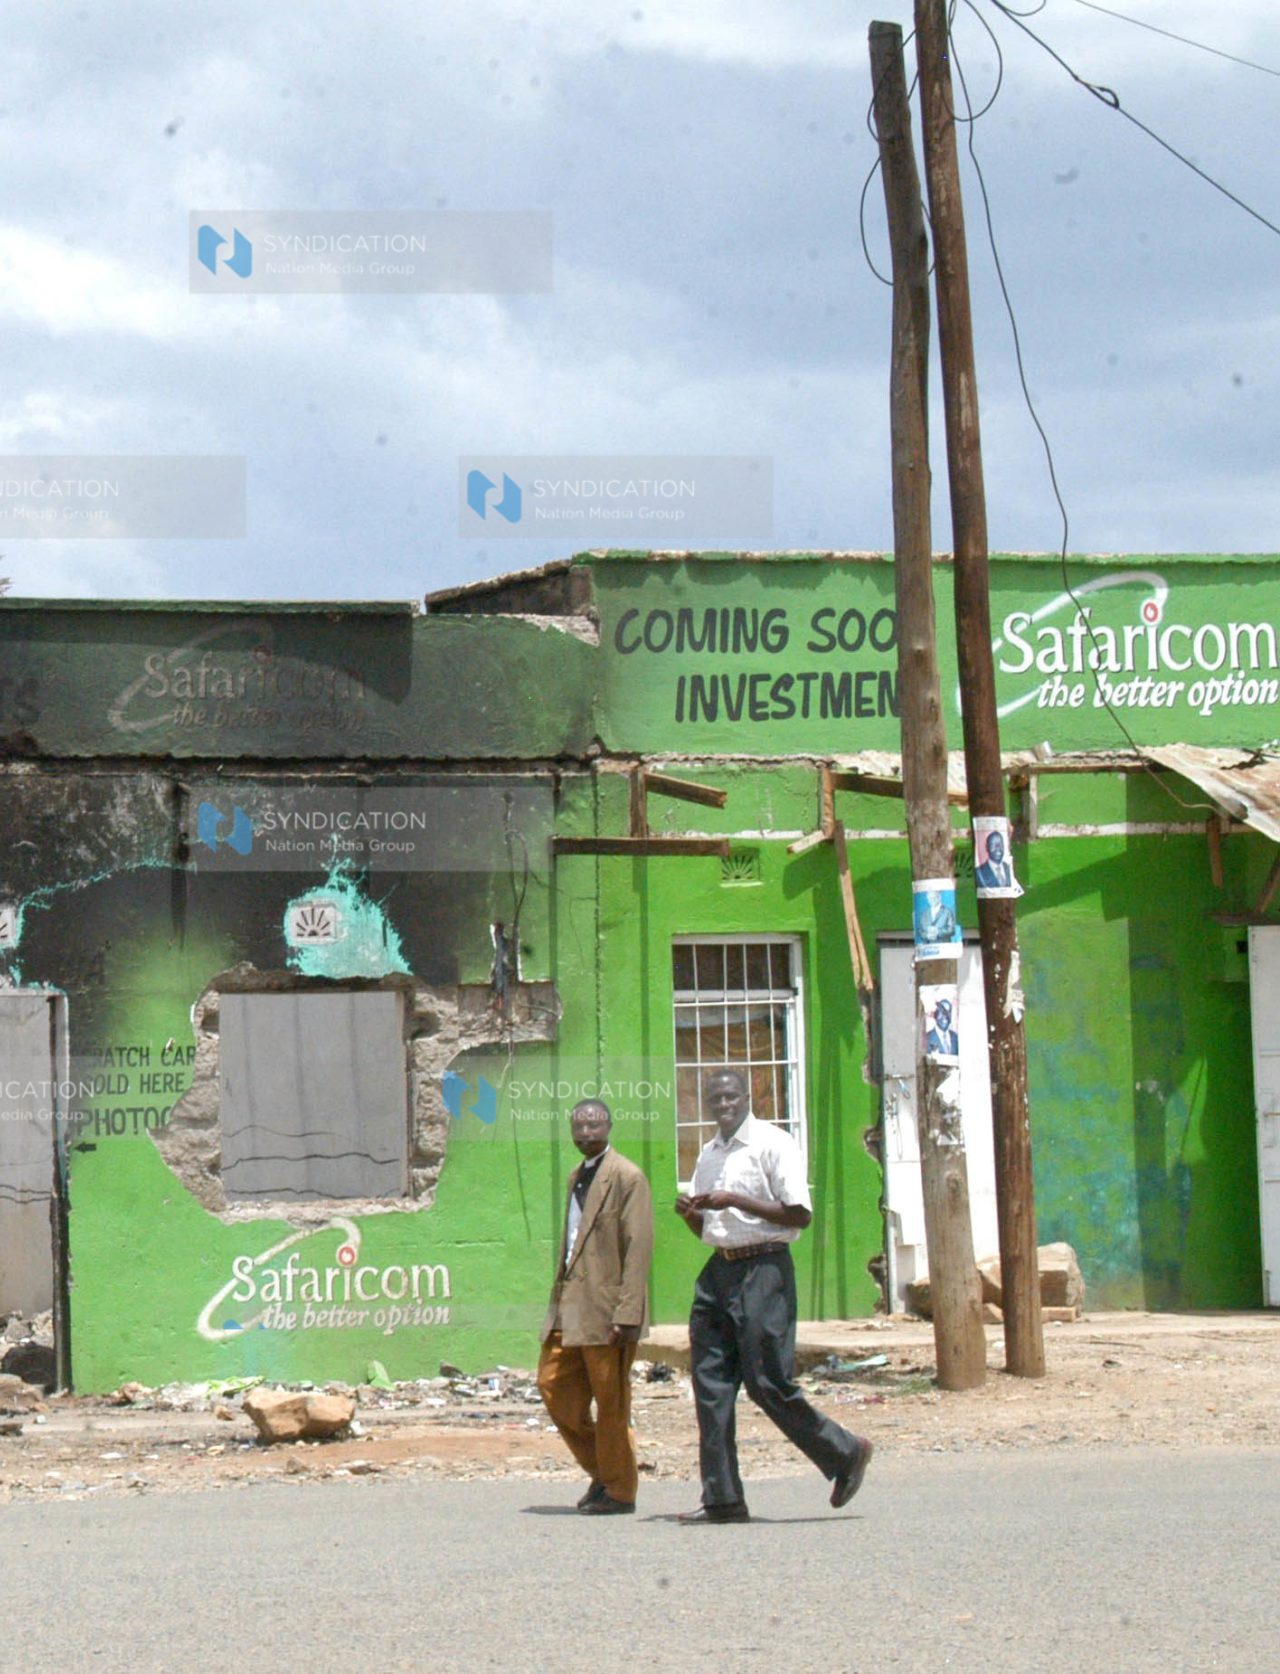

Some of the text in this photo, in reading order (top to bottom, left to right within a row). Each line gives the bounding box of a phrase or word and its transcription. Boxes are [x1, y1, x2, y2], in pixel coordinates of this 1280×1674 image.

[614, 607, 898, 654] COMING SOO
[999, 607, 1280, 674] Safaricom
[674, 670, 901, 723] INVESTMEN
[1037, 669, 1279, 717] the better option
[161, 1045, 197, 1068] CAR
[140, 1072, 185, 1095] HERE
[231, 1252, 452, 1304] Safaricom
[263, 1301, 451, 1336] the better option
